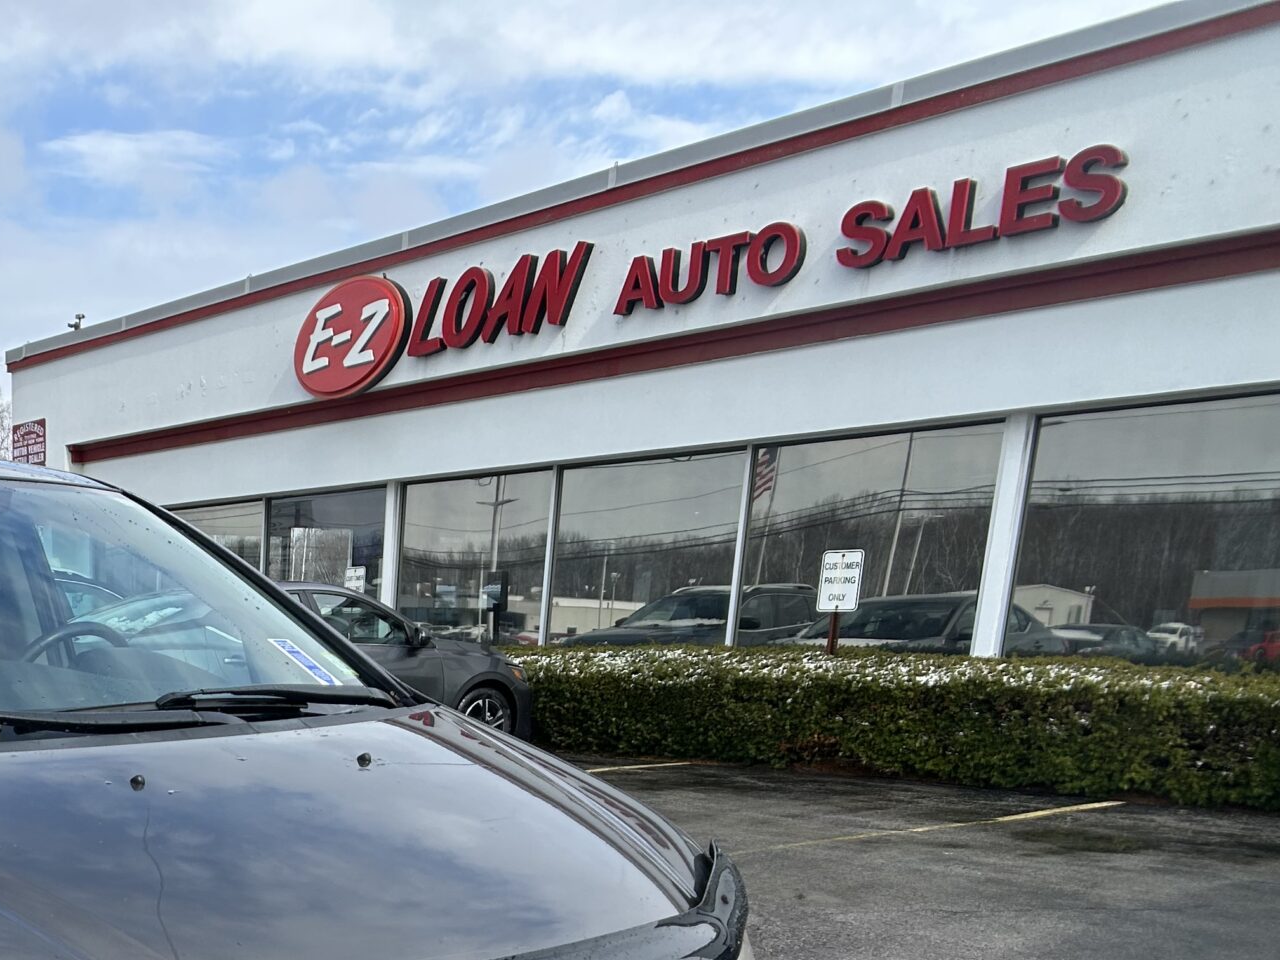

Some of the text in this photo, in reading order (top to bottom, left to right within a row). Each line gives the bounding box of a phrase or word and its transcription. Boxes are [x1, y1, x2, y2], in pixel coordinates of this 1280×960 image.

[301, 143, 1129, 376] E-Z LOAN AUTO SALES
[14, 422, 44, 442] REGISTERED
[28, 442, 45, 453] VEHICLE
[28, 452, 44, 464] DEALER
[824, 561, 860, 570] CUSTOMER
[824, 576, 856, 584] PARKING
[828, 593, 847, 602] ONLY
